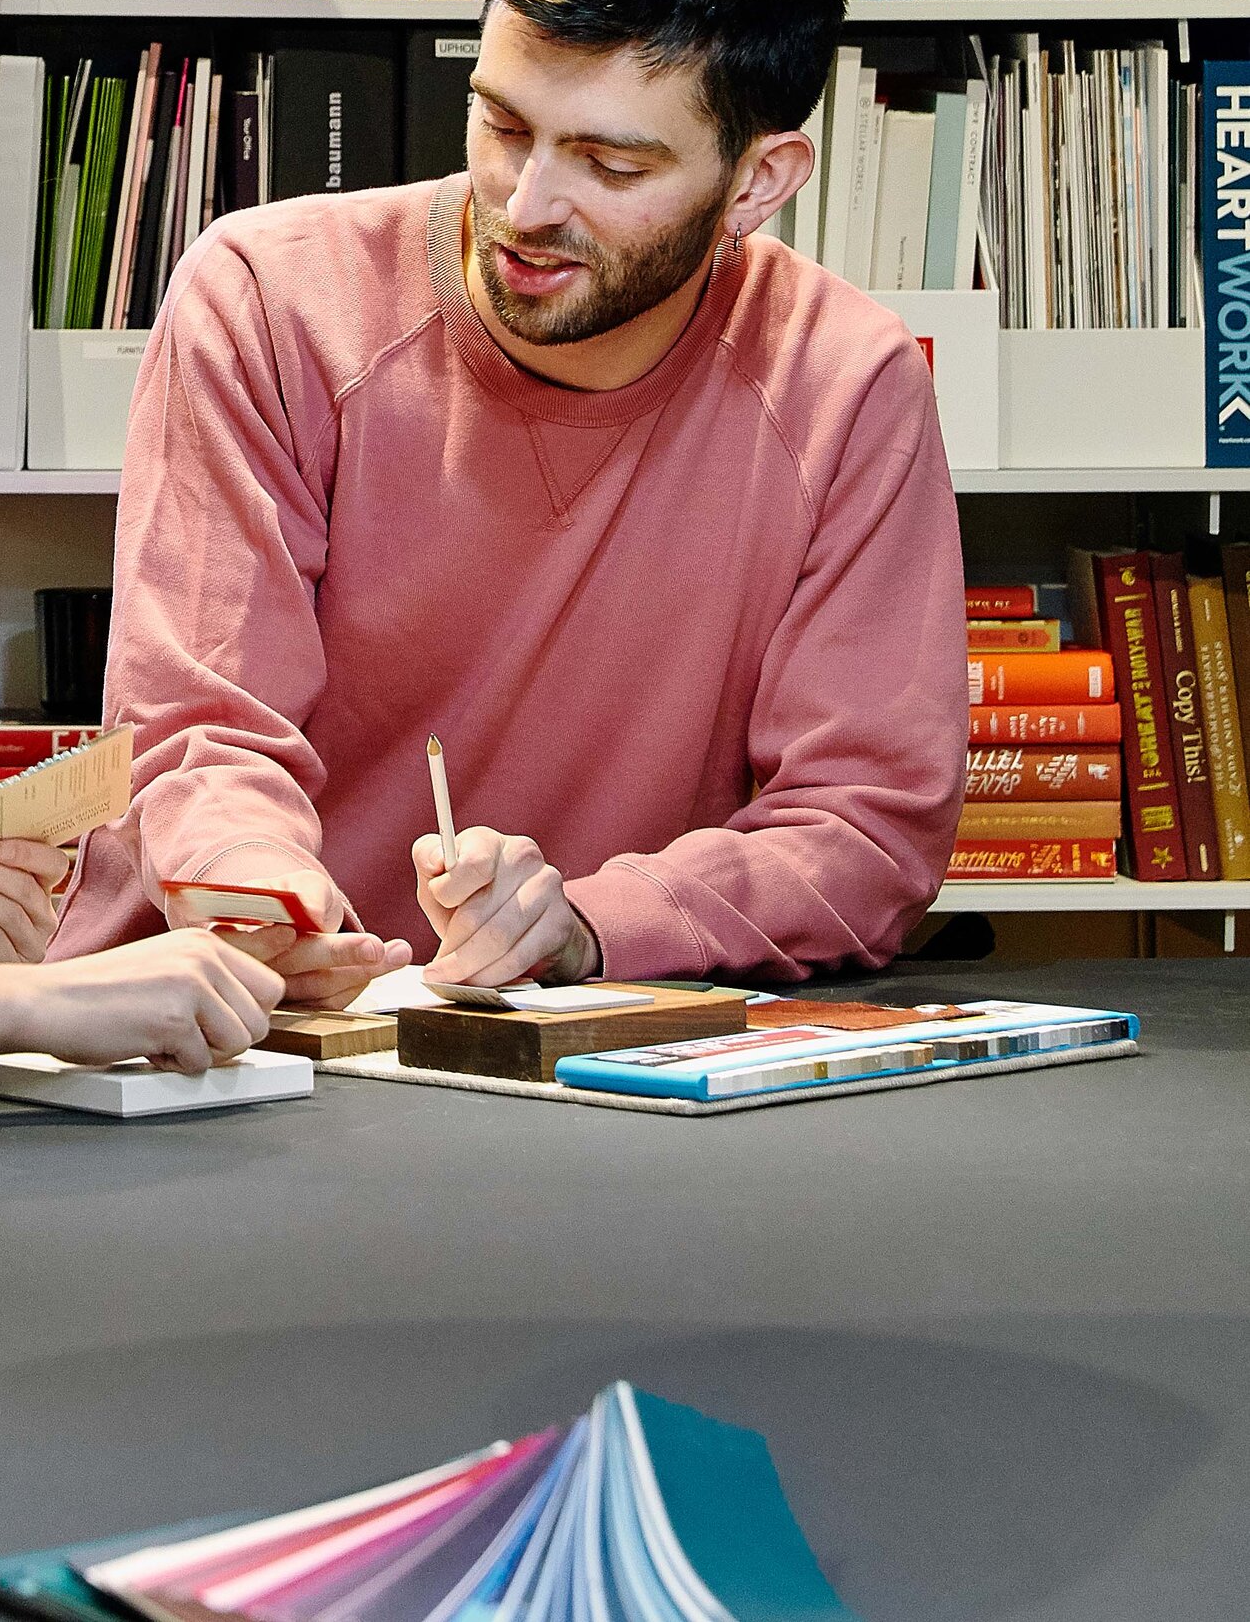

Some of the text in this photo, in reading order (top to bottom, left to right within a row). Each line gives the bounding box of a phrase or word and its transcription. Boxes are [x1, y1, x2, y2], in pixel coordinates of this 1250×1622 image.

[325, 91, 343, 189] baumann
[967, 131, 978, 185] CONTRACT
[1172, 669, 1198, 725] Copy
[1199, 643, 1226, 791] THE POMEGRANATE
[1220, 685, 1232, 714] HER
[1134, 693, 1160, 767] GREAT
[1180, 727, 1207, 783] This!
[1223, 717, 1236, 749] AND
